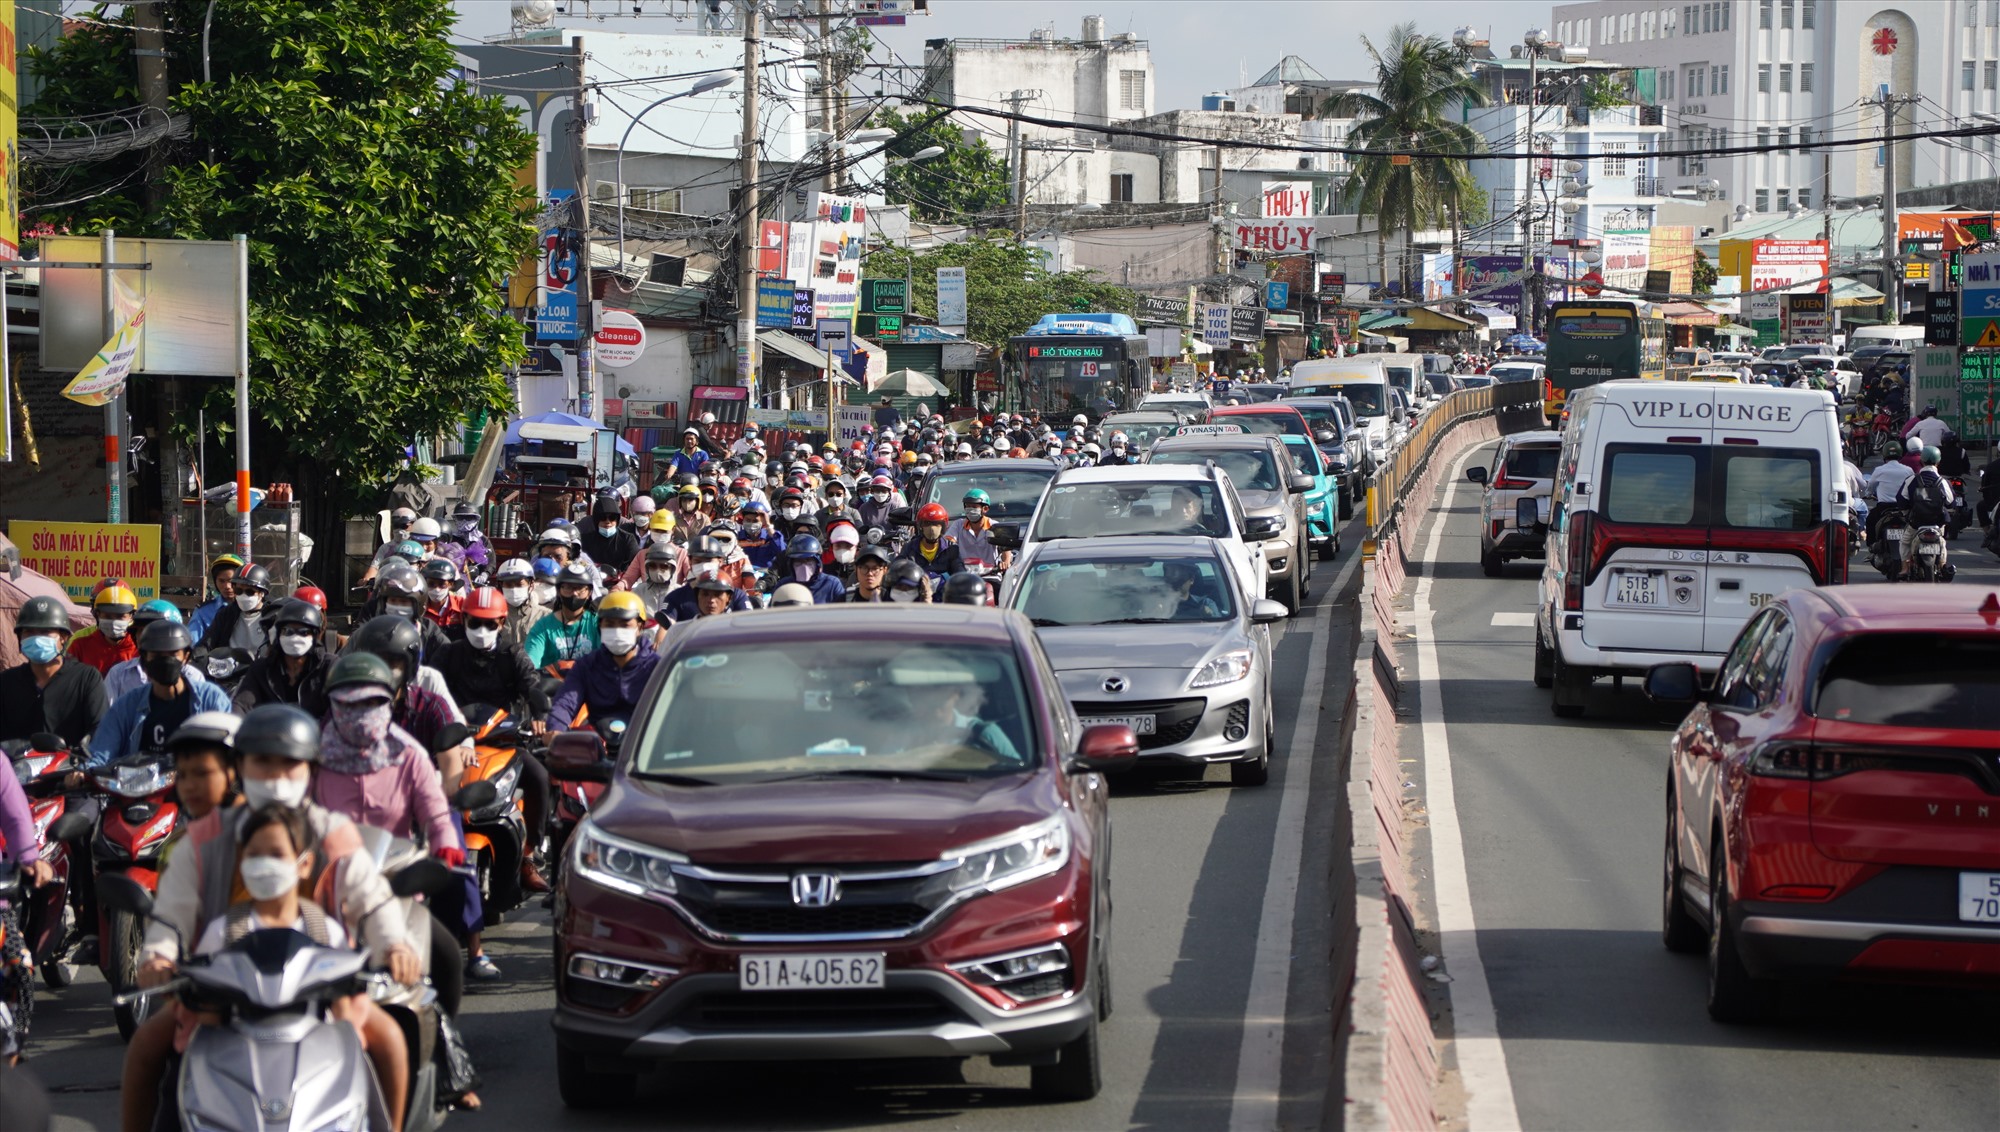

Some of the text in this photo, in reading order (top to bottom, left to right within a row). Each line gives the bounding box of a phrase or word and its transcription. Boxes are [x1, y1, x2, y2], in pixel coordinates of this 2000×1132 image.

[1237, 220, 1314, 251] THÚ-Y
[1968, 262, 1990, 282] NHÀ
[876, 284, 903, 296] KARAOKE
[1146, 299, 1164, 310] THE
[1793, 300, 1823, 308] UTEN
[1936, 296, 1951, 307] NHÀ
[549, 306, 570, 320] LOẠI
[1208, 307, 1228, 318] HỚT
[1931, 310, 1955, 323] THUỐC
[1208, 318, 1227, 328] TÓC
[1808, 318, 1824, 326] PHÁT
[599, 332, 636, 341] Cleansui
[1205, 330, 1228, 339] NAM
[1936, 328, 1950, 338] TÂY
[1926, 350, 1952, 366] NHÀ
[1965, 356, 1981, 365] NHÀ
[1083, 363, 1096, 375] 19
[1570, 367, 1612, 376] 60F-011.85
[1632, 402, 1792, 422] VIP LOUNGE
[33, 527, 139, 553] SỬA MÁY LẤY LIỀN
[1668, 551, 1750, 563] DCAR
[20, 558, 38, 572] HO
[42, 556, 70, 577] THUÊ
[74, 556, 97, 578] CÁC
[130, 557, 155, 578] MÁY
[1627, 576, 1648, 590] 51B
[68, 584, 83, 597] MÁY
[1617, 590, 1656, 604] 414.61
[746, 958, 879, 986] 61A-405.62
